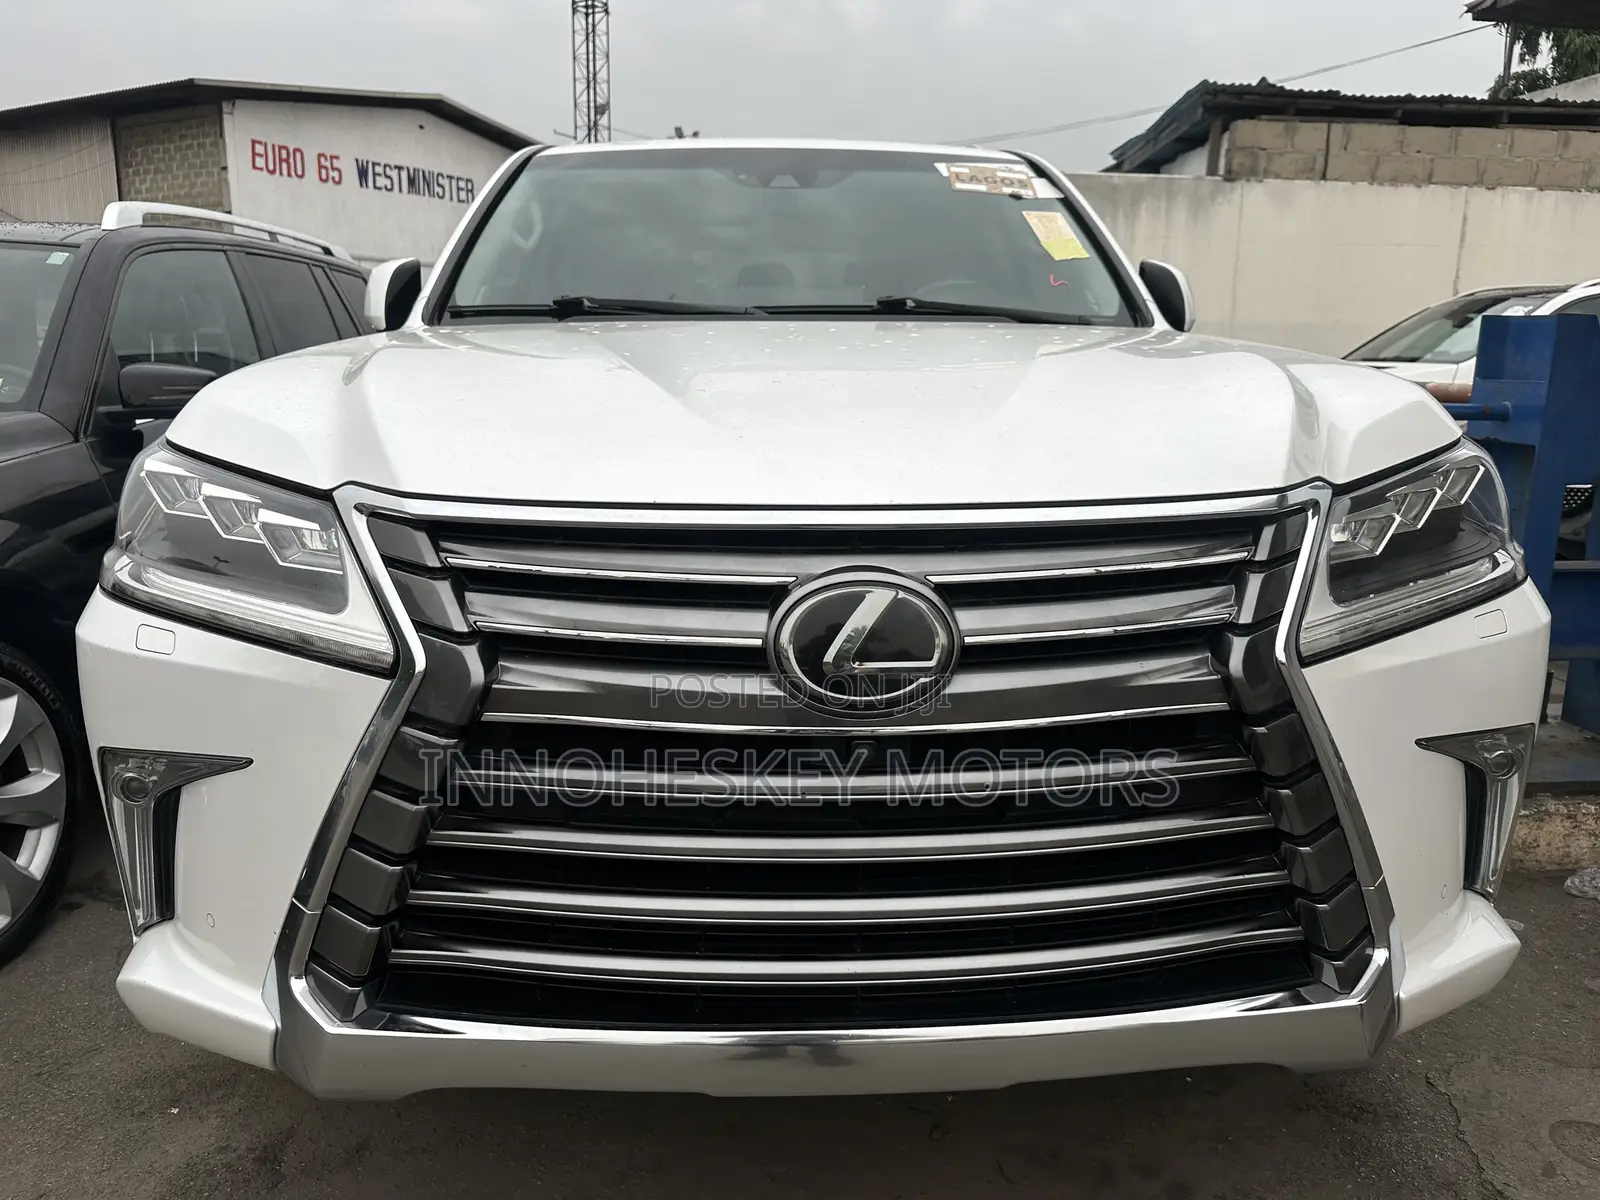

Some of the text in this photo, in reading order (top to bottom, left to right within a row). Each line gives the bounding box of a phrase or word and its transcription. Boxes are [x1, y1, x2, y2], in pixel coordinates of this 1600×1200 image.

[250, 138, 475, 205] EURO 65 WESTMINISTER
[954, 172, 1029, 188] LAGOS
